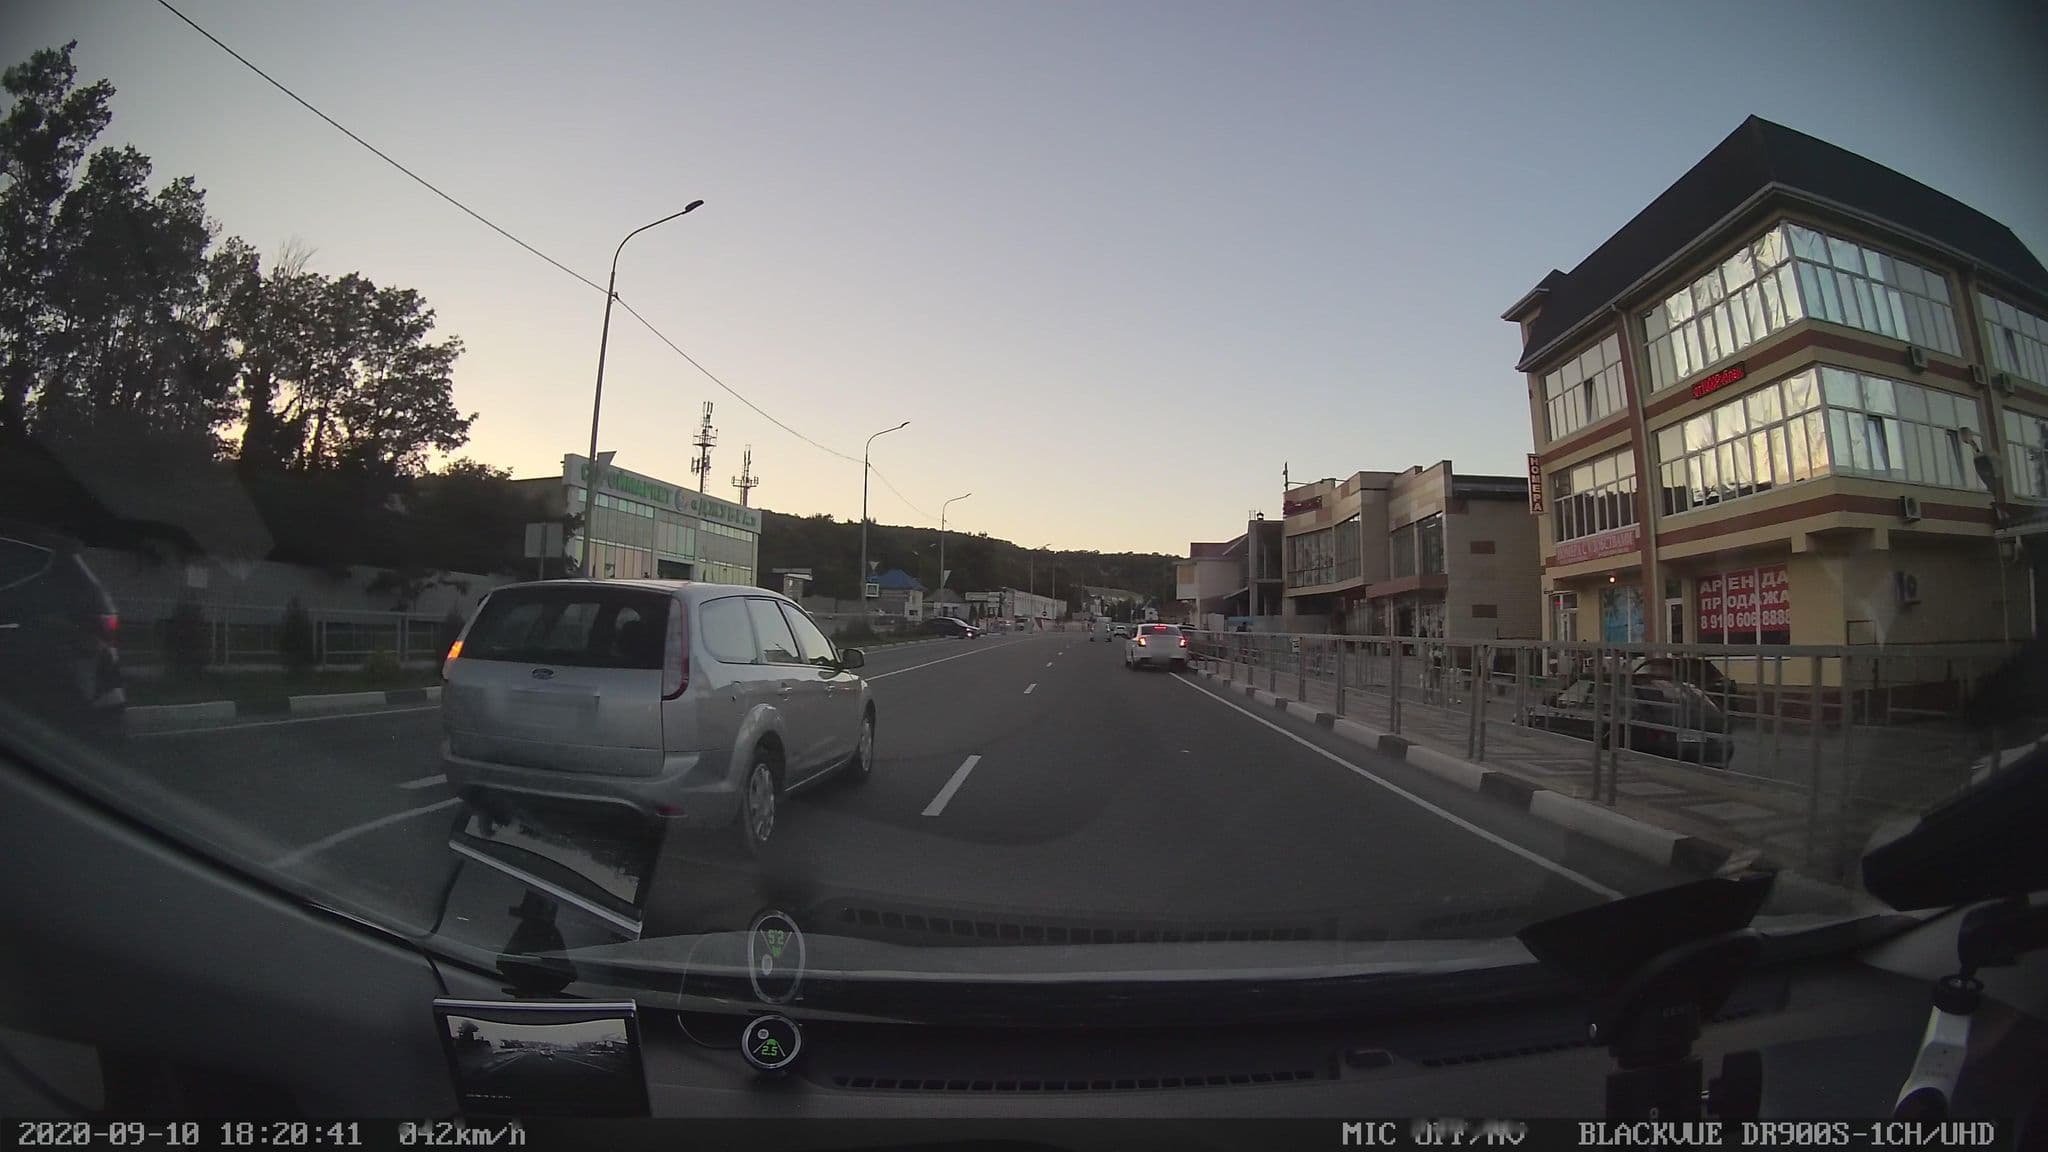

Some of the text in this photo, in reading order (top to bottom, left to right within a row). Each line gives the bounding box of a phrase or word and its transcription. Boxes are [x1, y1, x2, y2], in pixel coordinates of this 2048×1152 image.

[1530, 457, 1542, 511] НОМЕРА
[1700, 570, 1788, 594] АРЕНДА
[1702, 590, 1790, 611] ПРОДАЖА
[1701, 615, 1708, 629] 8
[761, 1045, 778, 1056] 2.5
